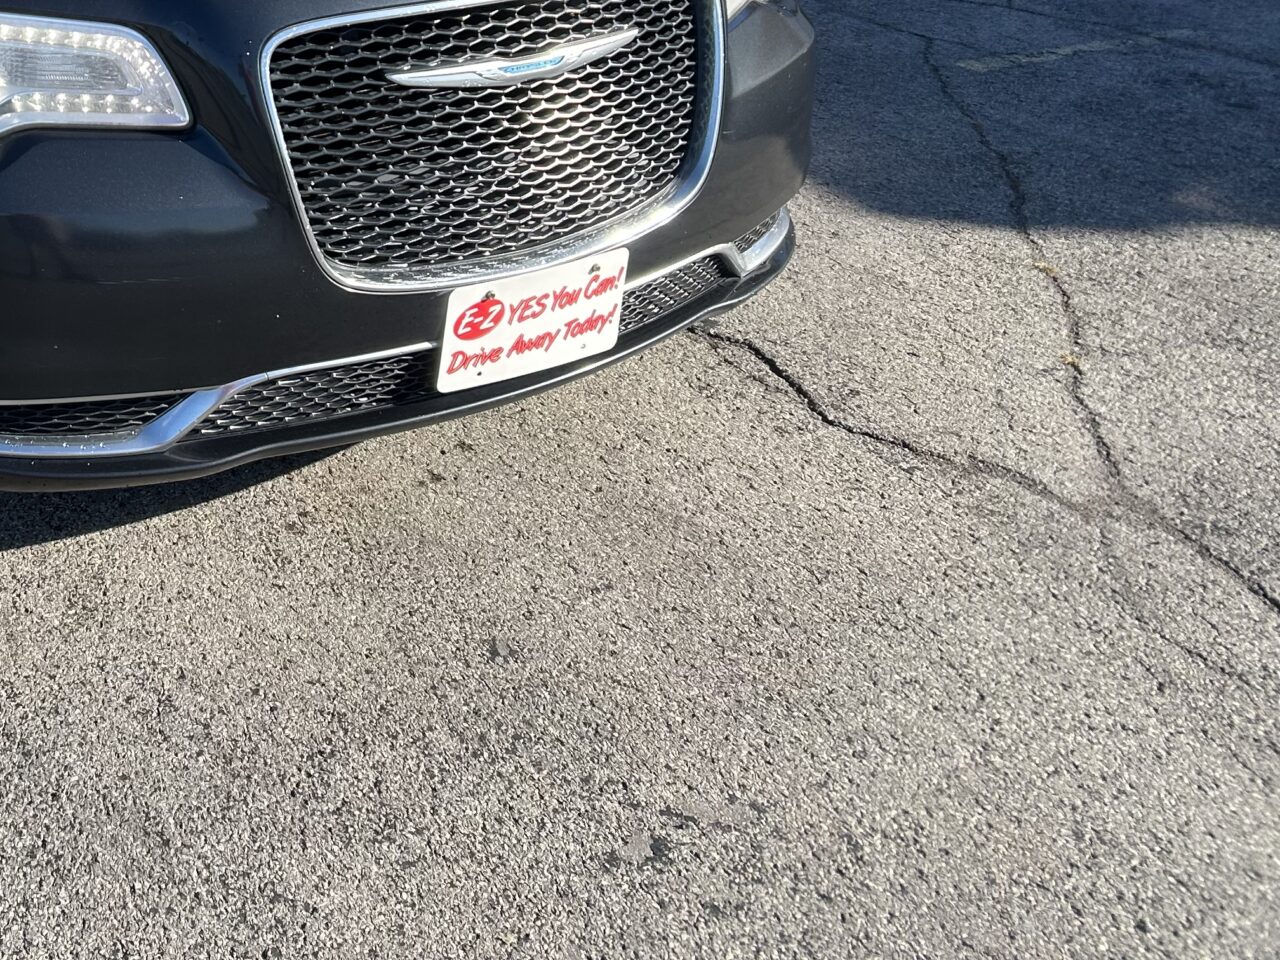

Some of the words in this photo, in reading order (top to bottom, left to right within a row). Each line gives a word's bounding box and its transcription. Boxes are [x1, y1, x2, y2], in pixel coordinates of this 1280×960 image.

[455, 304, 504, 338] E-Z
[508, 292, 551, 326] YES
[551, 285, 582, 312] You
[583, 266, 624, 300] Can!
[446, 347, 504, 375] Drive
[506, 328, 561, 359] Away
[562, 303, 618, 340] Today!
